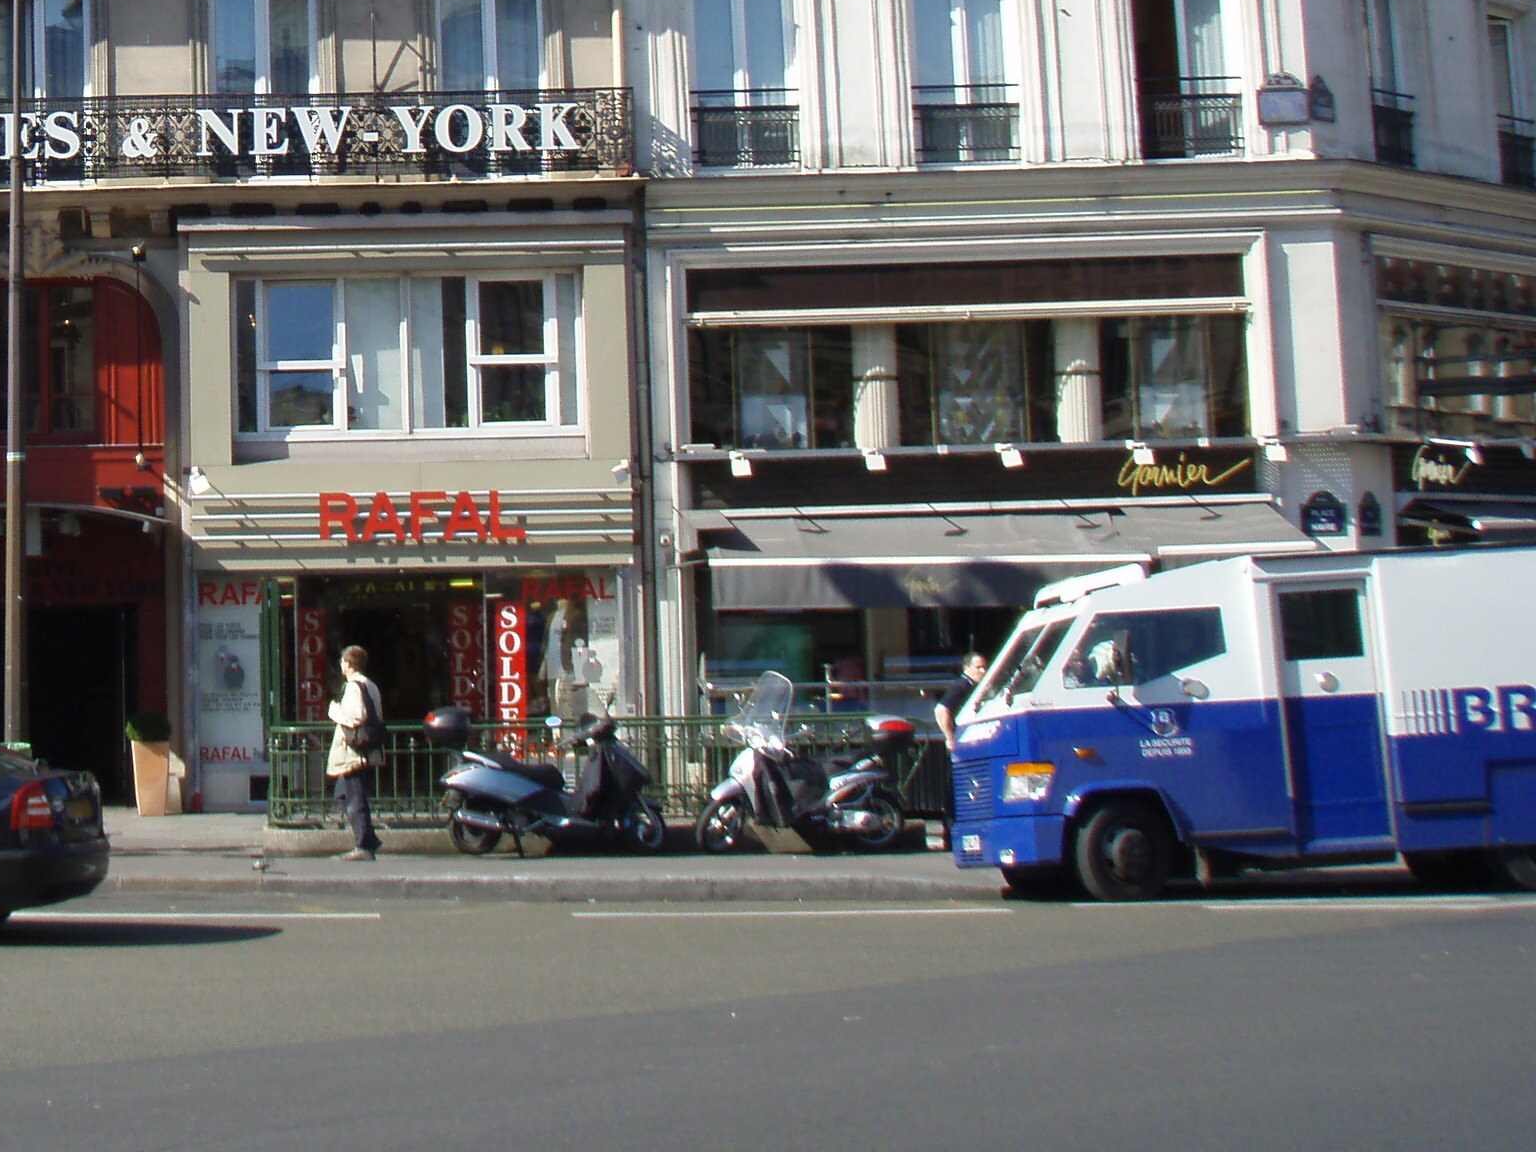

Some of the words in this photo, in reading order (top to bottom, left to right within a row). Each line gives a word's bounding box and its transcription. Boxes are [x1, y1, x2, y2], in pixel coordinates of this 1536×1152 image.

[121, 117, 158, 158] &
[196, 102, 583, 156] NEW-YORK
[1117, 450, 1253, 497] Garnier
[319, 490, 526, 543] RAFAL
[198, 582, 263, 606] RAF
[520, 577, 616, 603] RAFAL
[199, 746, 252, 762] RAFAL
